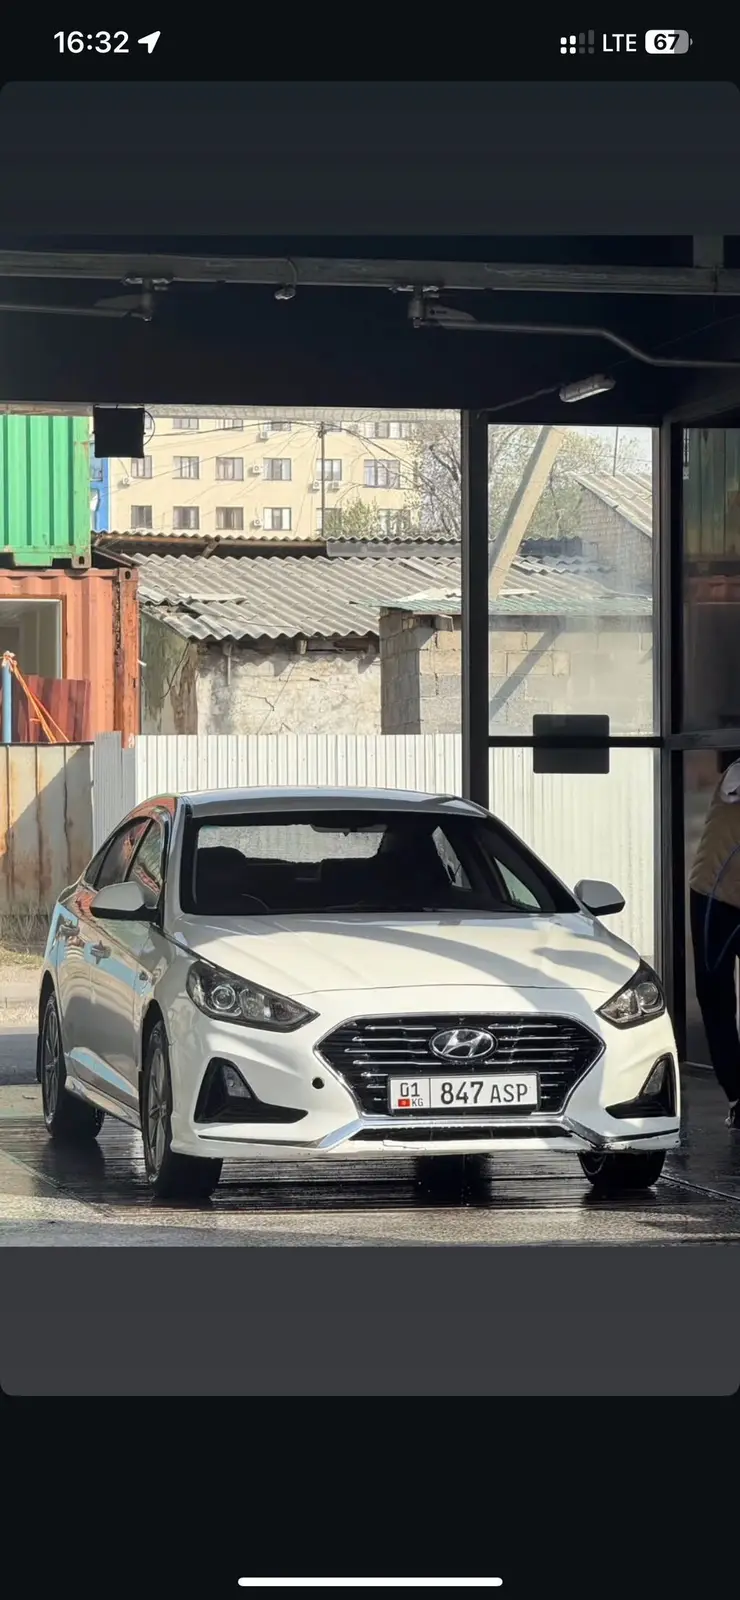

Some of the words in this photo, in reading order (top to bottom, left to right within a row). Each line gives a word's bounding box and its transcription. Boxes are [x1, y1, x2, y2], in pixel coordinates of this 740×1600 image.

[400, 1082, 420, 1098] 01
[440, 1081, 484, 1105] 847
[490, 1083, 528, 1104] ASP
[411, 1098, 424, 1107] KG
